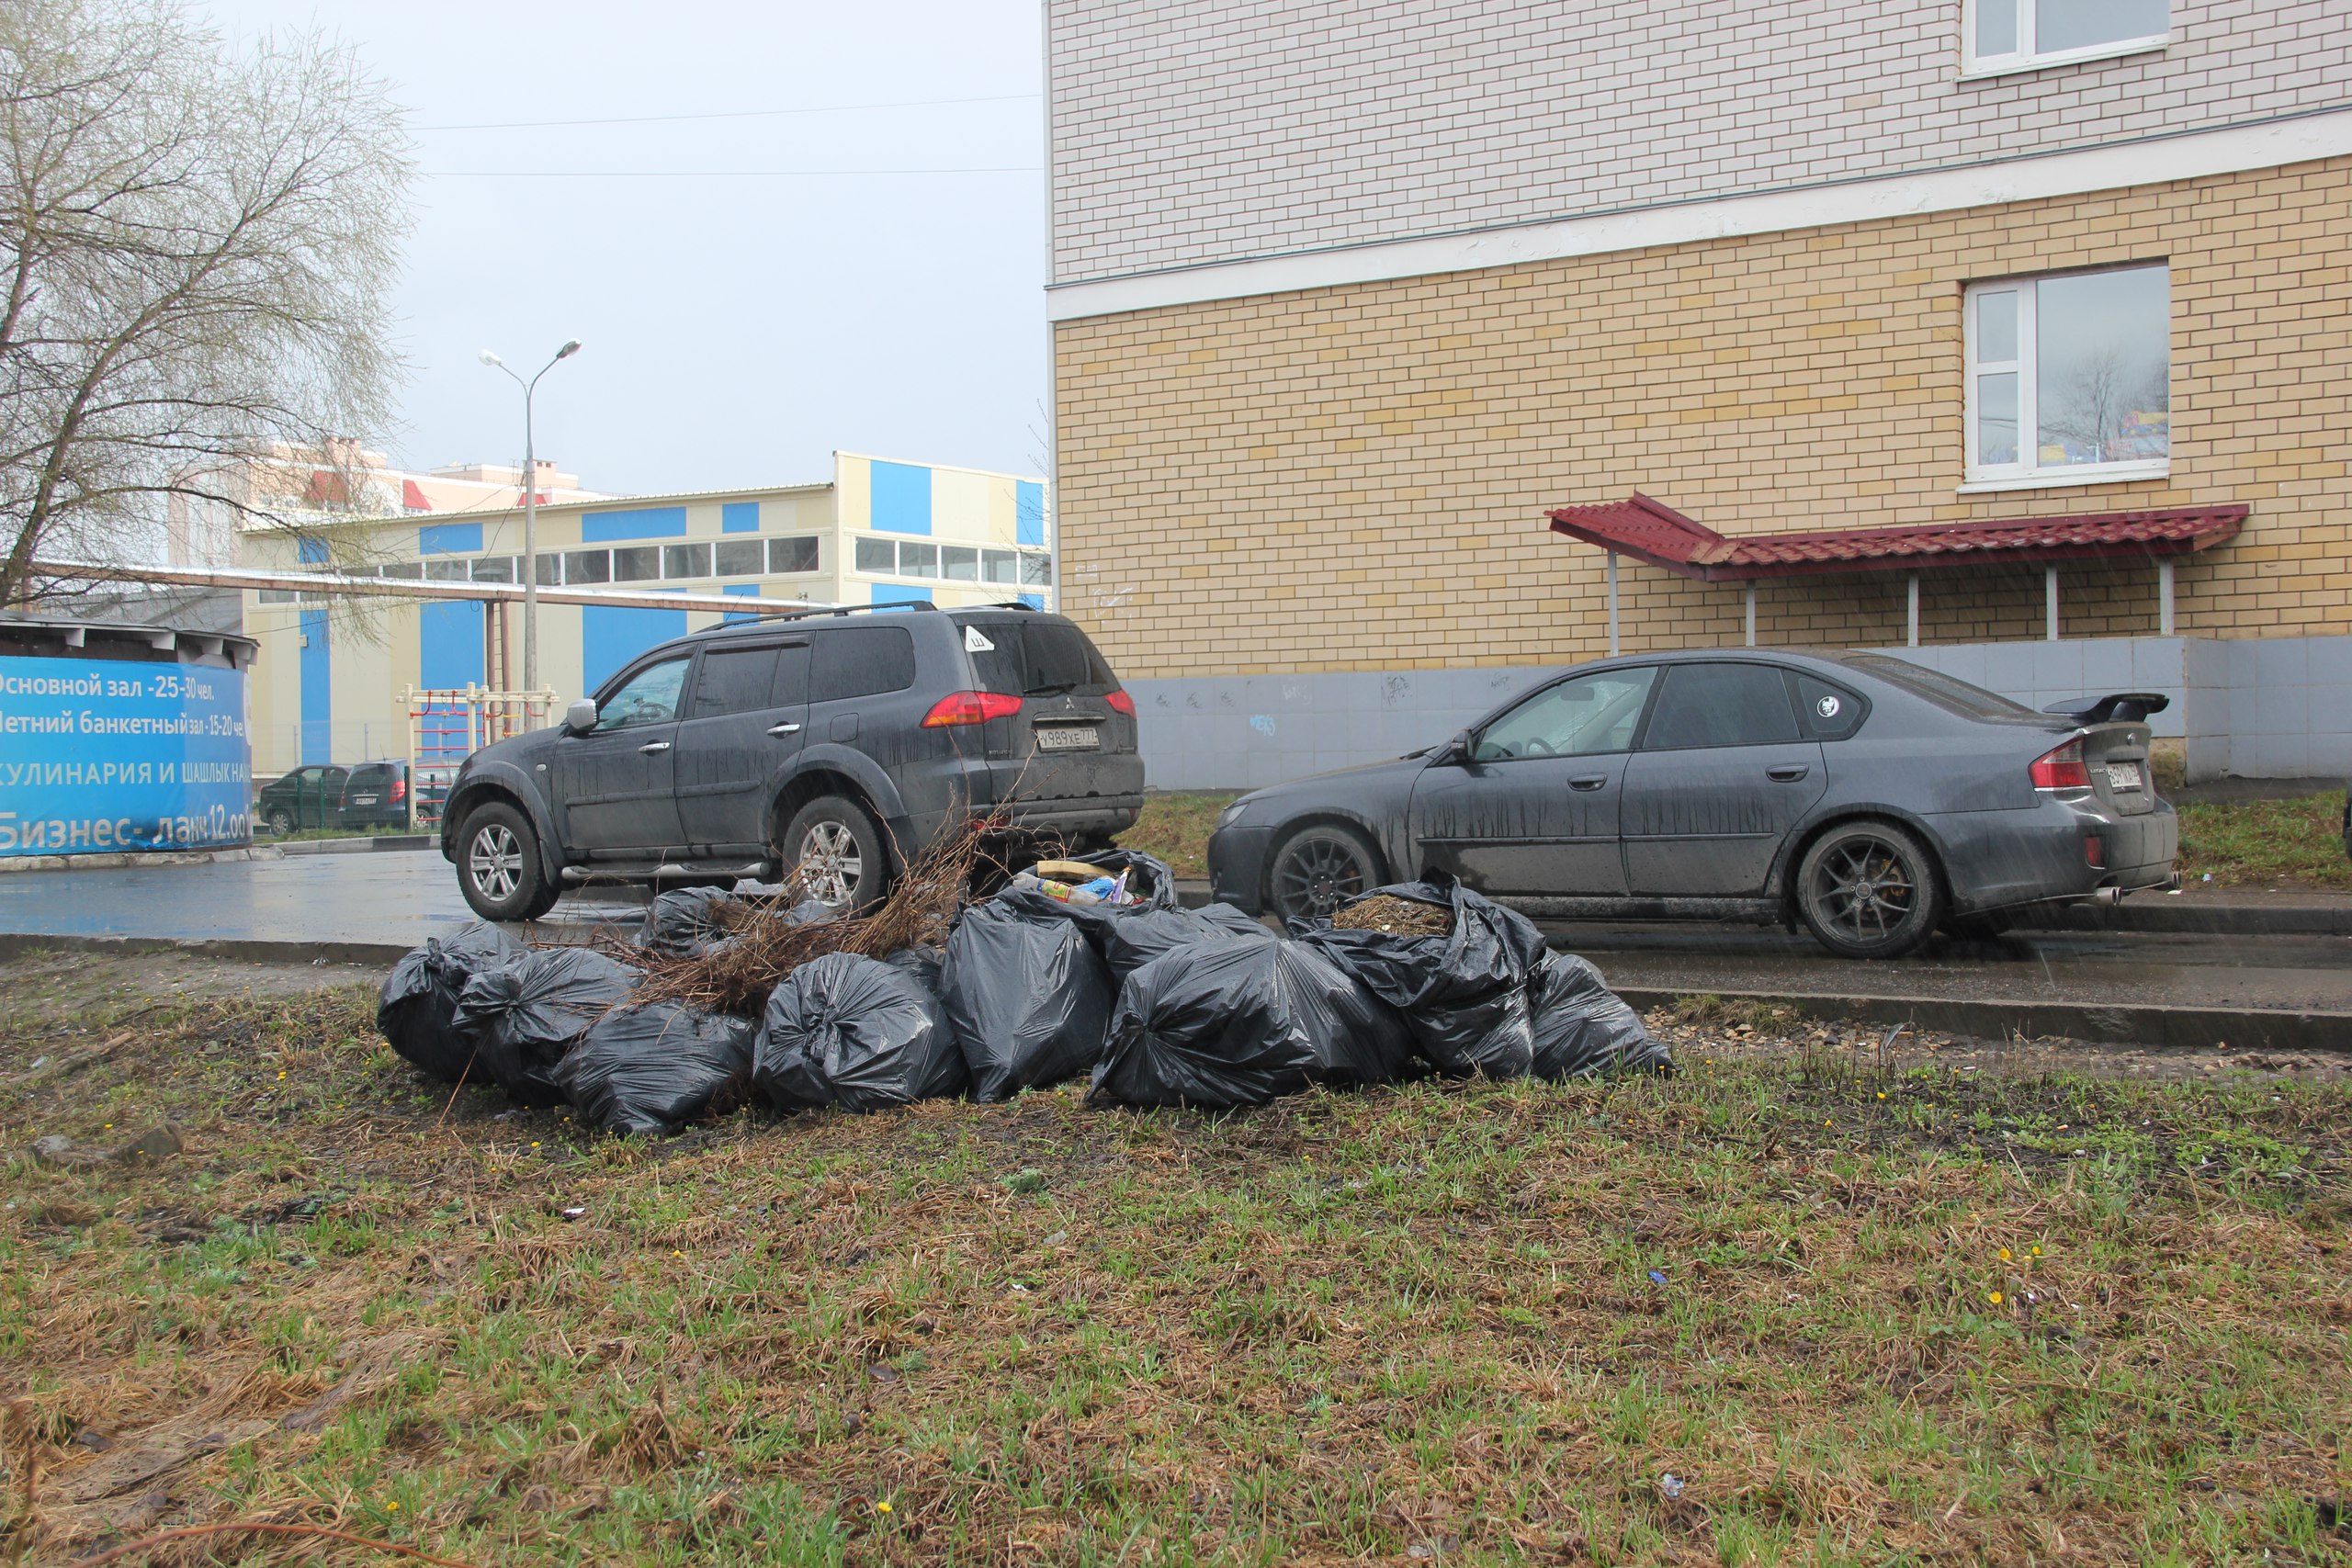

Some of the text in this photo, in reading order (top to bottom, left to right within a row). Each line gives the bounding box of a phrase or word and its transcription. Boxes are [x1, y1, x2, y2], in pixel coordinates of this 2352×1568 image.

[970, 637, 986, 648] Ш
[0, 672, 102, 696] сновной
[107, 680, 141, 697] зал
[198, 683, 215, 700] чел.
[0, 710, 74, 734] етний
[80, 710, 187, 735] банкетный
[188, 719, 204, 735] зал
[159, 762, 175, 784] И
[182, 762, 230, 784] ШАШЛЫК
[153, 816, 208, 844] ланч
